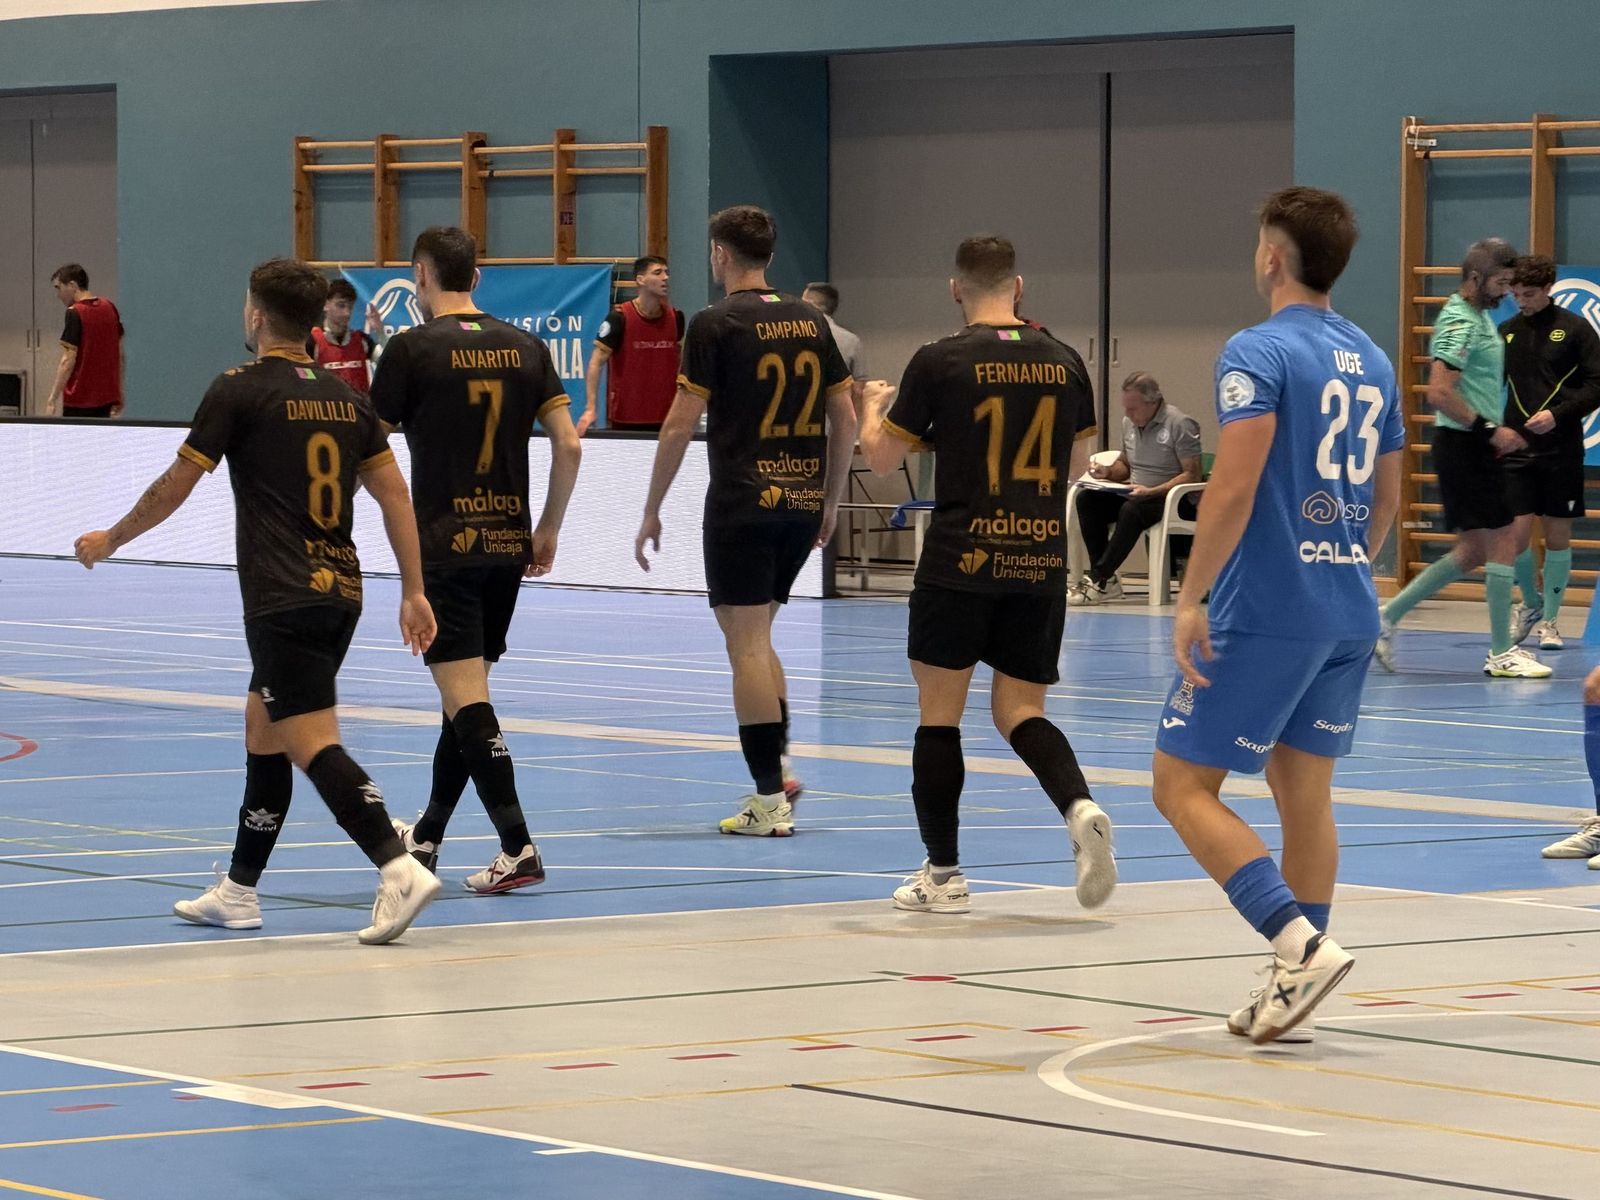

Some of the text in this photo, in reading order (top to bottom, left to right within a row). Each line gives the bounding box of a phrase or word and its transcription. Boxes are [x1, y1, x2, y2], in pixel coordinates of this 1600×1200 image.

[756, 320, 818, 341] CAMPANO
[451, 349, 521, 369] ALVARITO
[542, 337, 584, 379] ALA
[1333, 350, 1364, 376] UGE
[975, 362, 1067, 385] FERNANDO
[757, 350, 822, 439] 22
[286, 400, 357, 422] DAVILILLO
[467, 378, 504, 474] 7
[1316, 378, 1384, 485] 23
[974, 395, 1057, 496] 14
[307, 432, 341, 530] 8
[482, 540, 523, 556] Unicaja
[993, 551, 1063, 568] Fundación
[992, 563, 1046, 584] Unicaja
